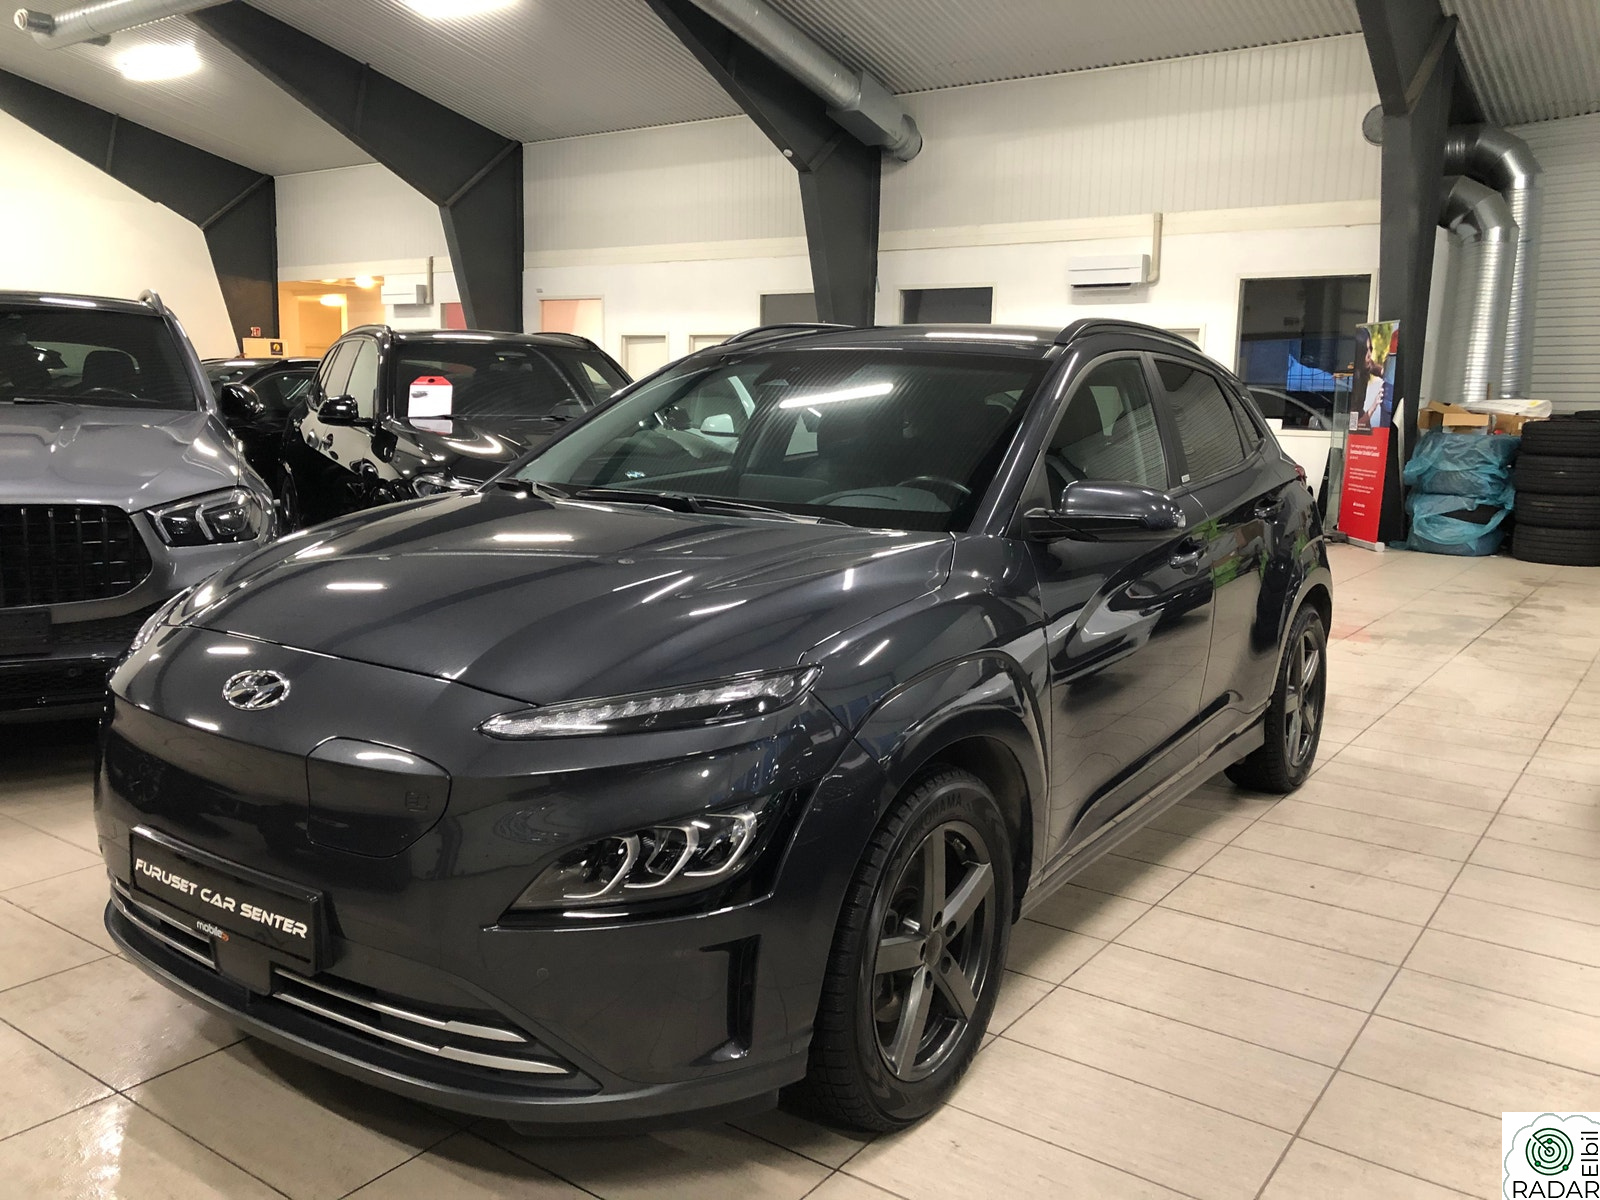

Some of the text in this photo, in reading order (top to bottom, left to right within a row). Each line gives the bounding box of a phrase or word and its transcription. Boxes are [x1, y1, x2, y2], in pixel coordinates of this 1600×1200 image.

[135, 858, 308, 939] FURUSET CAR SENTER
